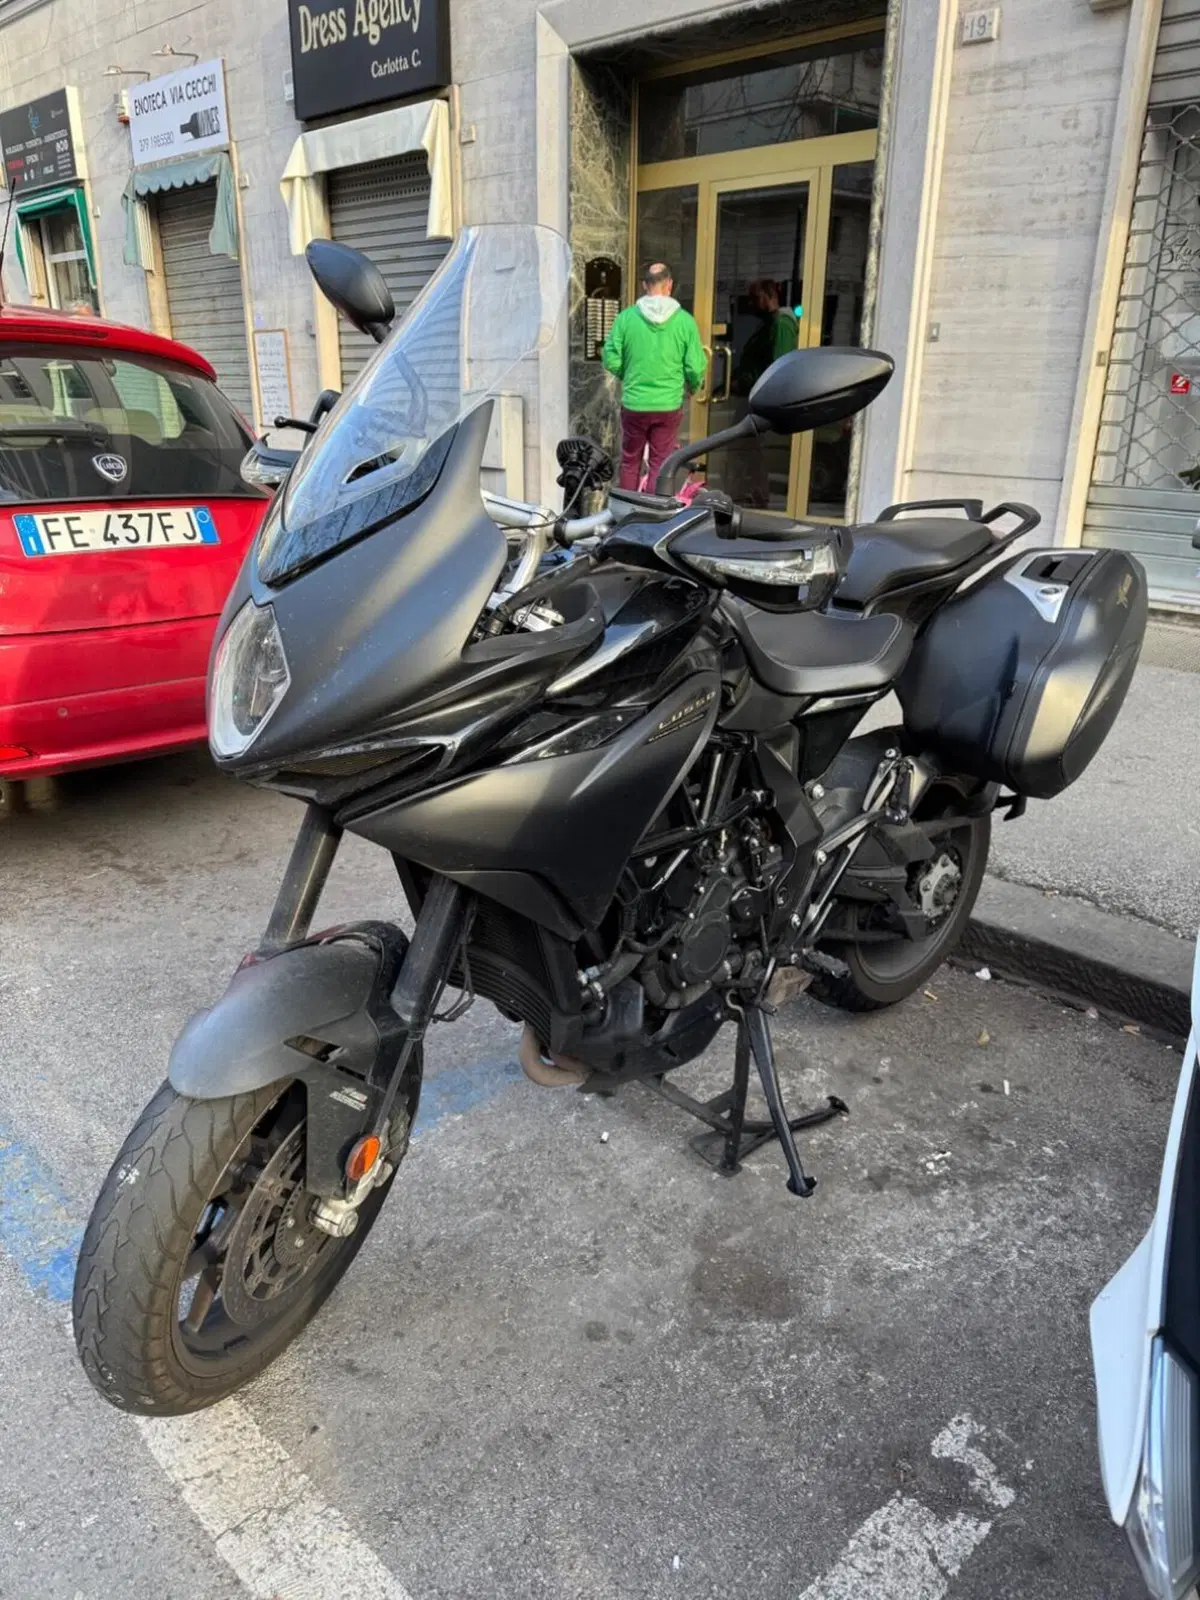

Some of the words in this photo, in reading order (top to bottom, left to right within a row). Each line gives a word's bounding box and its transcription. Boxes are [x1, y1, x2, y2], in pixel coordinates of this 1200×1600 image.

[298, 5, 347, 54] Dress
[353, 0, 421, 46] Agency
[371, 56, 409, 78] Carlotta
[411, 48, 422, 68] C.
[134, 90, 168, 116] ENOTECA
[169, 85, 186, 105] VIA
[185, 73, 217, 100] CECCHI
[41, 516, 90, 550] FE
[103, 511, 198, 546] 437FJ
